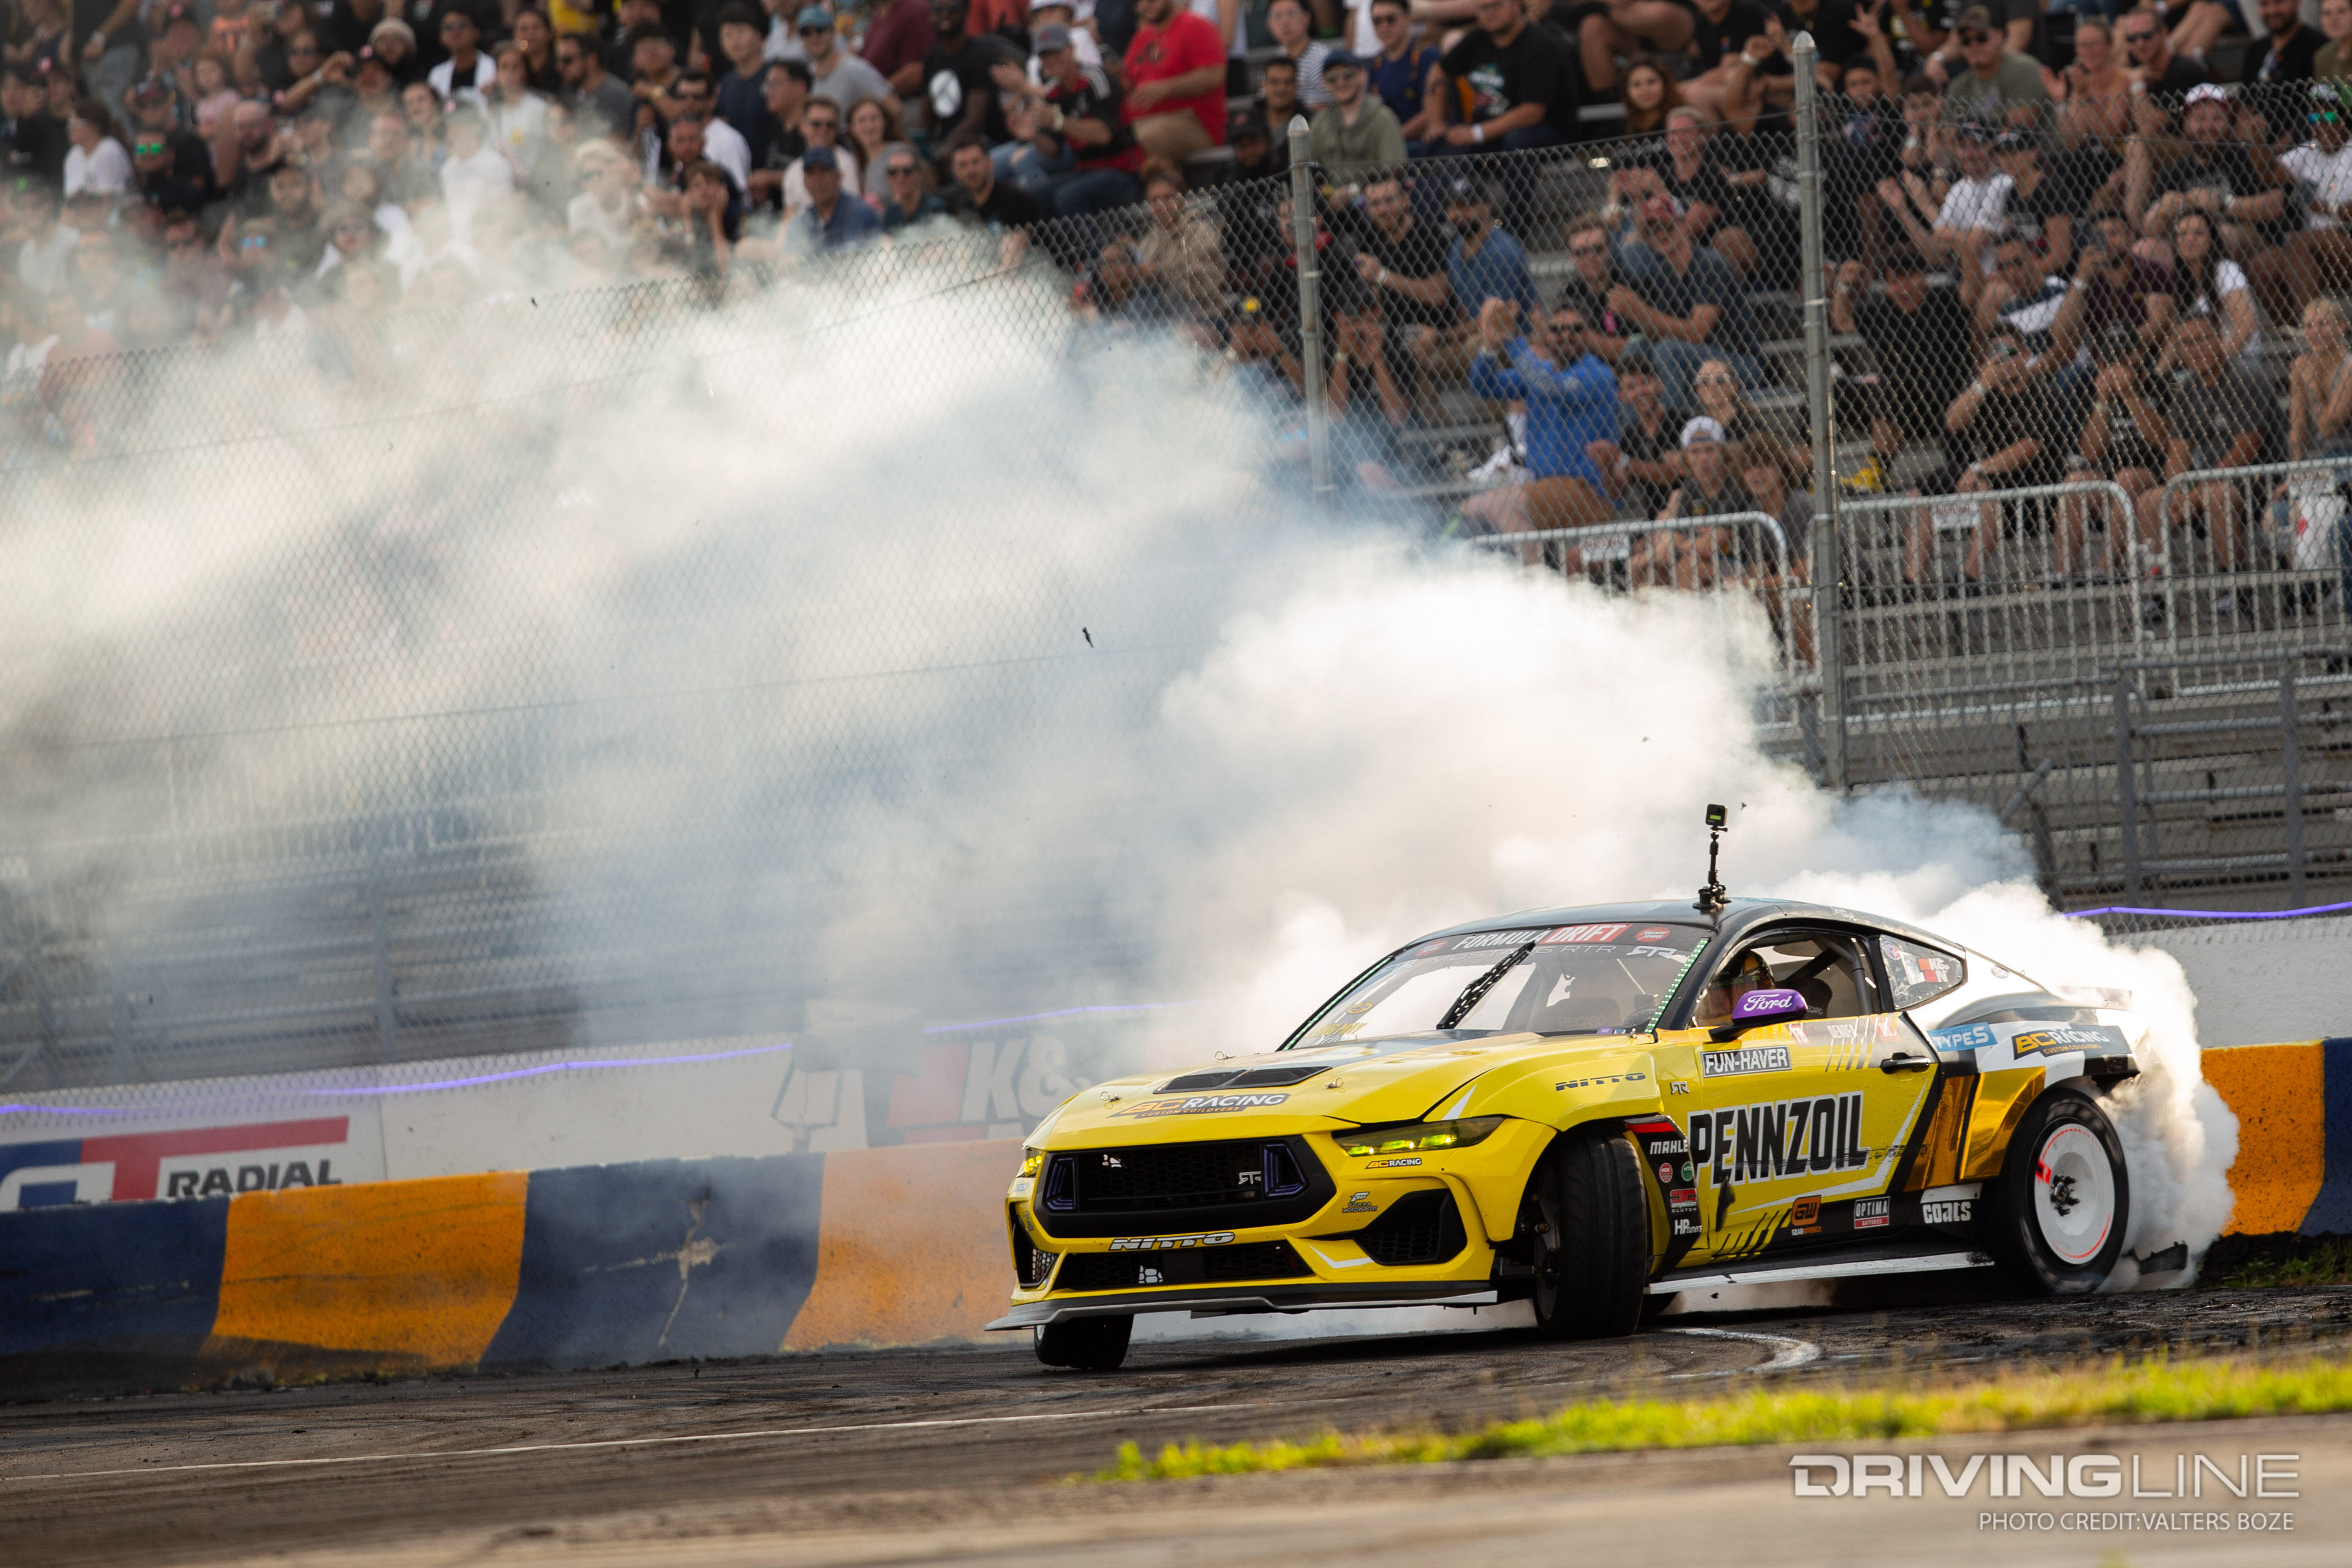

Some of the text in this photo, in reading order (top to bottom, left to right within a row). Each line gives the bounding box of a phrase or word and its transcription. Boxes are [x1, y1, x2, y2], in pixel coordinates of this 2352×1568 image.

[1452, 929, 1552, 950] FORMULA
[1545, 925, 1627, 943] DRIFT
[1936, 970, 1948, 982] N
[1743, 993, 1792, 1011] Ford
[1806, 1006, 1823, 1015] ECARO
[2015, 1031, 2110, 1054] BC RACING
[2043, 1046, 2068, 1055] CUSTOM
[1705, 1048, 1788, 1074] FUN-HAVER
[960, 1035, 1092, 1123] K&
[1556, 1072, 1646, 1091] NITTO
[1120, 1094, 1286, 1114] BC RACING
[1142, 1109, 1182, 1117] CUSTOM
[1649, 1139, 1688, 1155] MAHLE
[1688, 1092, 1871, 1187] PENNZOIL
[167, 1159, 342, 1197] RADIAL
[1795, 1202, 1817, 1221] GW
[1855, 1200, 1887, 1217] OPTIMA
[1109, 1232, 1234, 1250] NITTO
